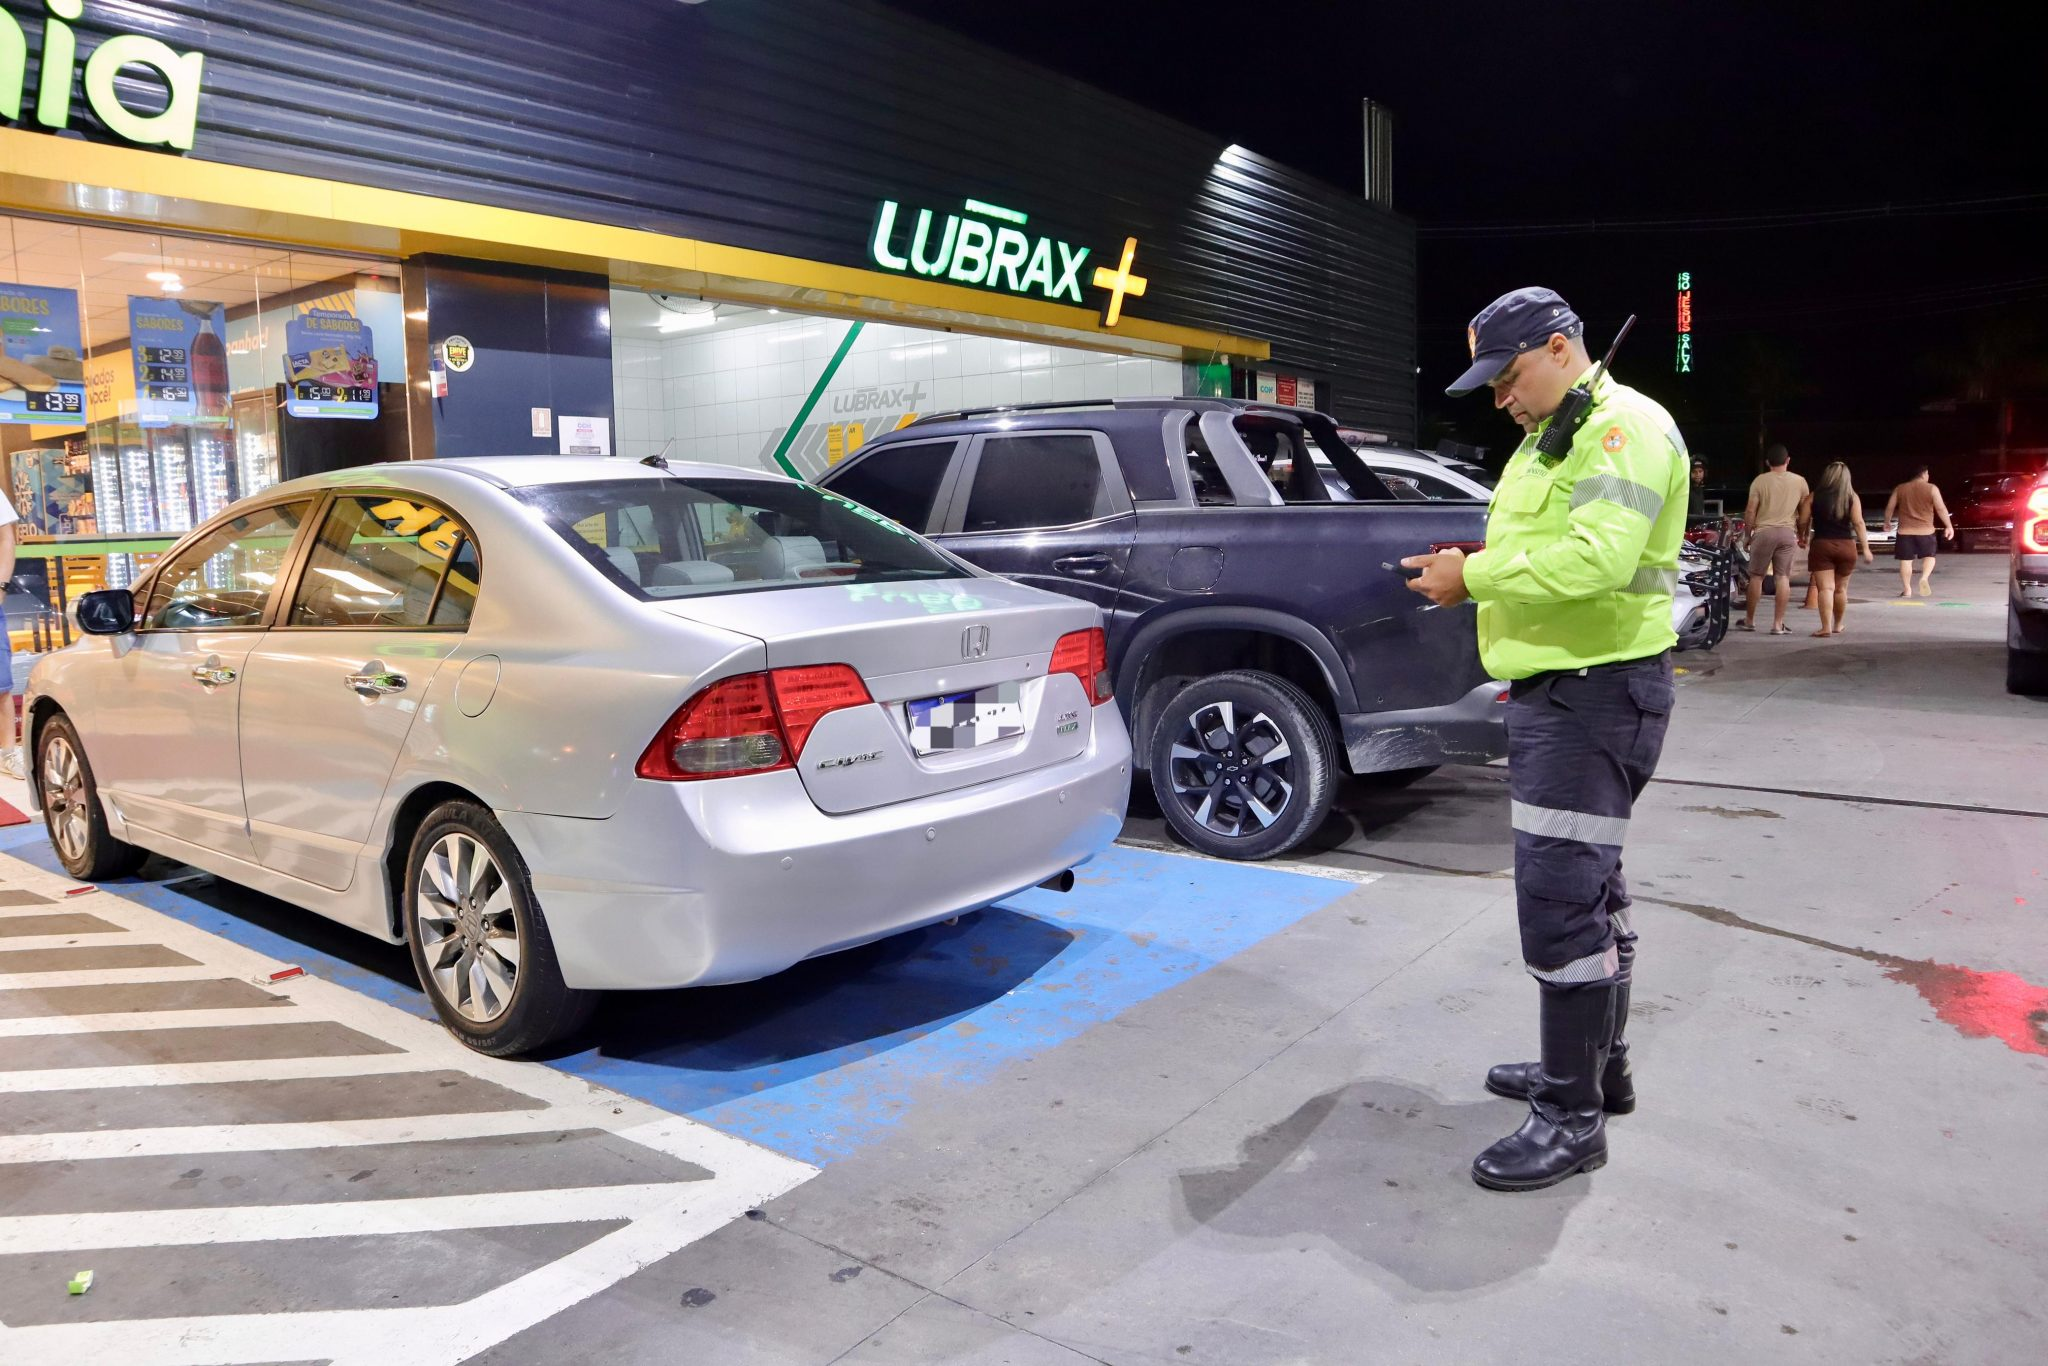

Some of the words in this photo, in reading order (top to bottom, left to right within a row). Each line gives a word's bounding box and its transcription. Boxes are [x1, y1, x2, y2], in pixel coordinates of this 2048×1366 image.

[136, 316, 184, 332] SABORES
[305, 317, 319, 330] DE
[320, 319, 361, 333] SABORES
[1681, 290, 1691, 332] JESUS
[1681, 333, 1691, 373] SALVA
